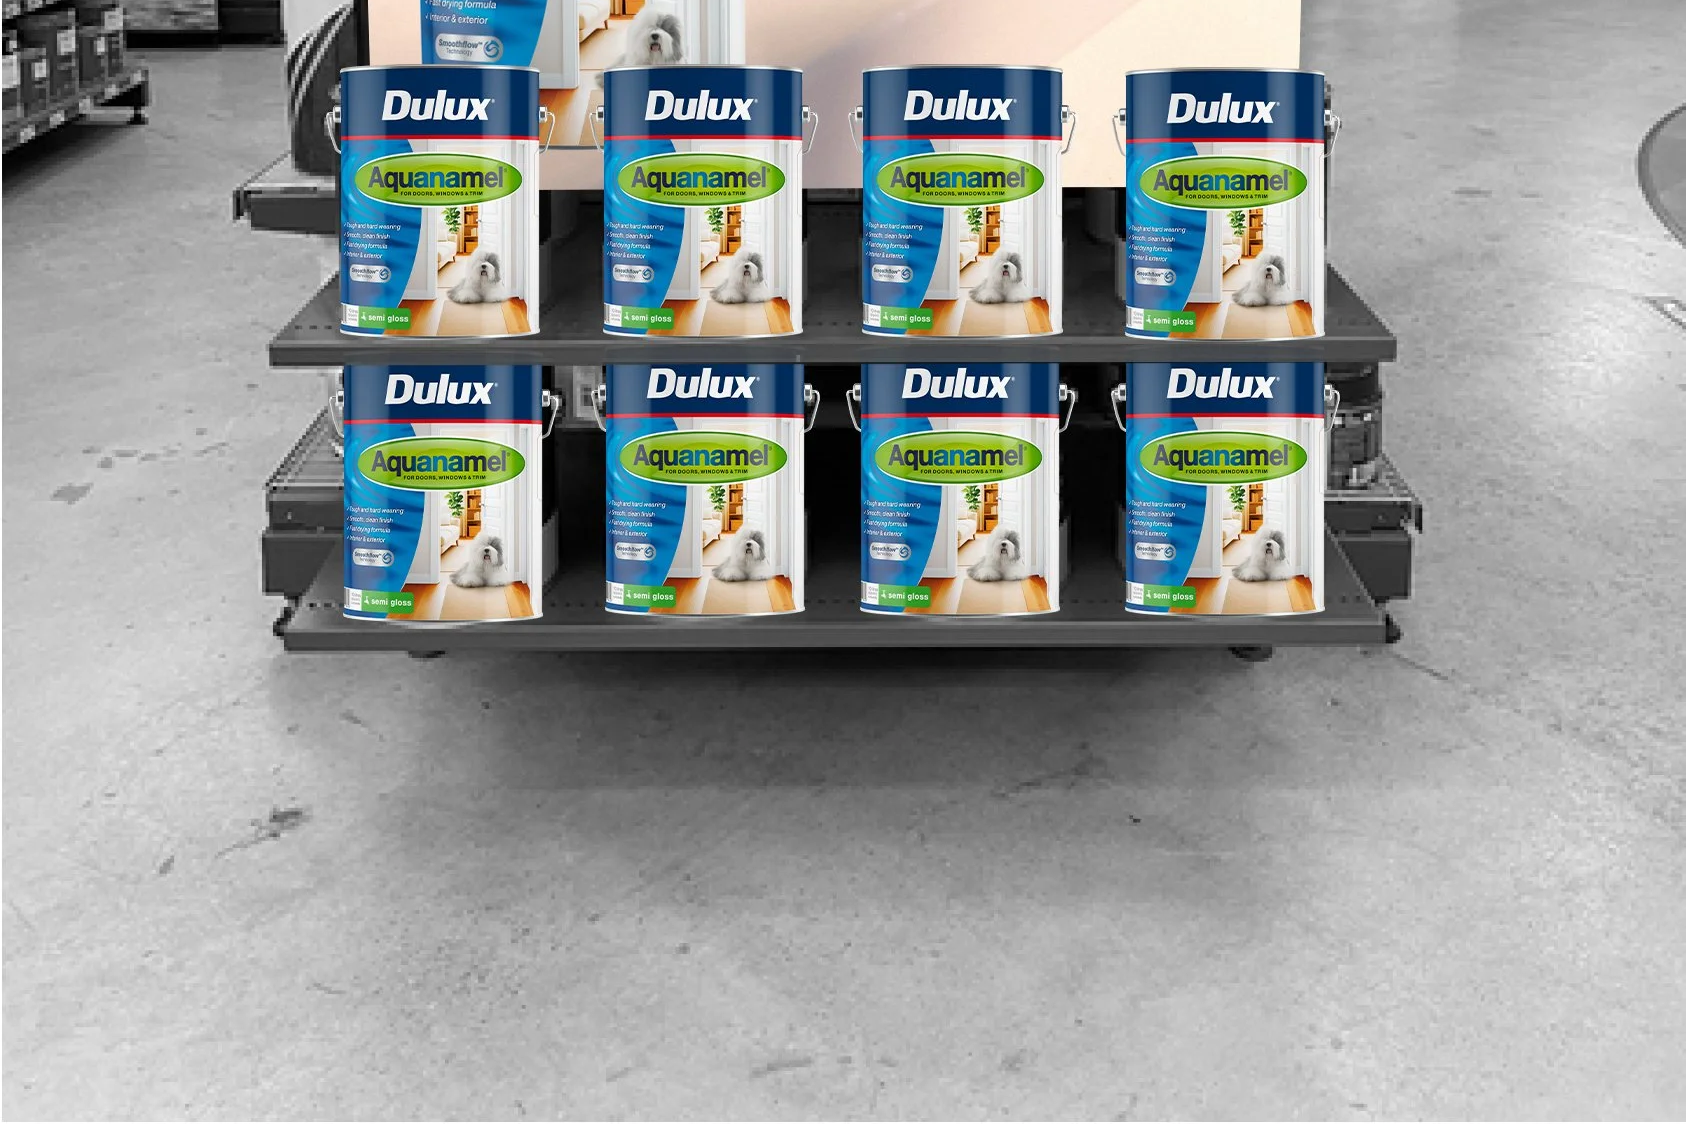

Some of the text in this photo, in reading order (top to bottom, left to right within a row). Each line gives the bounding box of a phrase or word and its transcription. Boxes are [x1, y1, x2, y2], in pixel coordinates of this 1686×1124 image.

[441, 0, 463, 10] drying
[464, 0, 497, 9] formula
[450, 14, 457, 23] &
[457, 15, 488, 25] exterior
[368, 313, 386, 322] semi
[387, 314, 409, 324] gloss
[631, 313, 649, 322] semi
[650, 314, 672, 324] gloss
[890, 313, 908, 322] semi
[909, 314, 931, 324] gloss
[1153, 316, 1171, 325] semi
[1172, 317, 1194, 327] gloss
[633, 591, 651, 600] semi
[652, 592, 674, 602] gloss
[888, 591, 906, 600] semi
[907, 592, 929, 602] gloss
[1153, 591, 1171, 600] semi
[1172, 592, 1194, 602] gloss
[371, 597, 389, 606] semi
[390, 598, 412, 608] gloss
